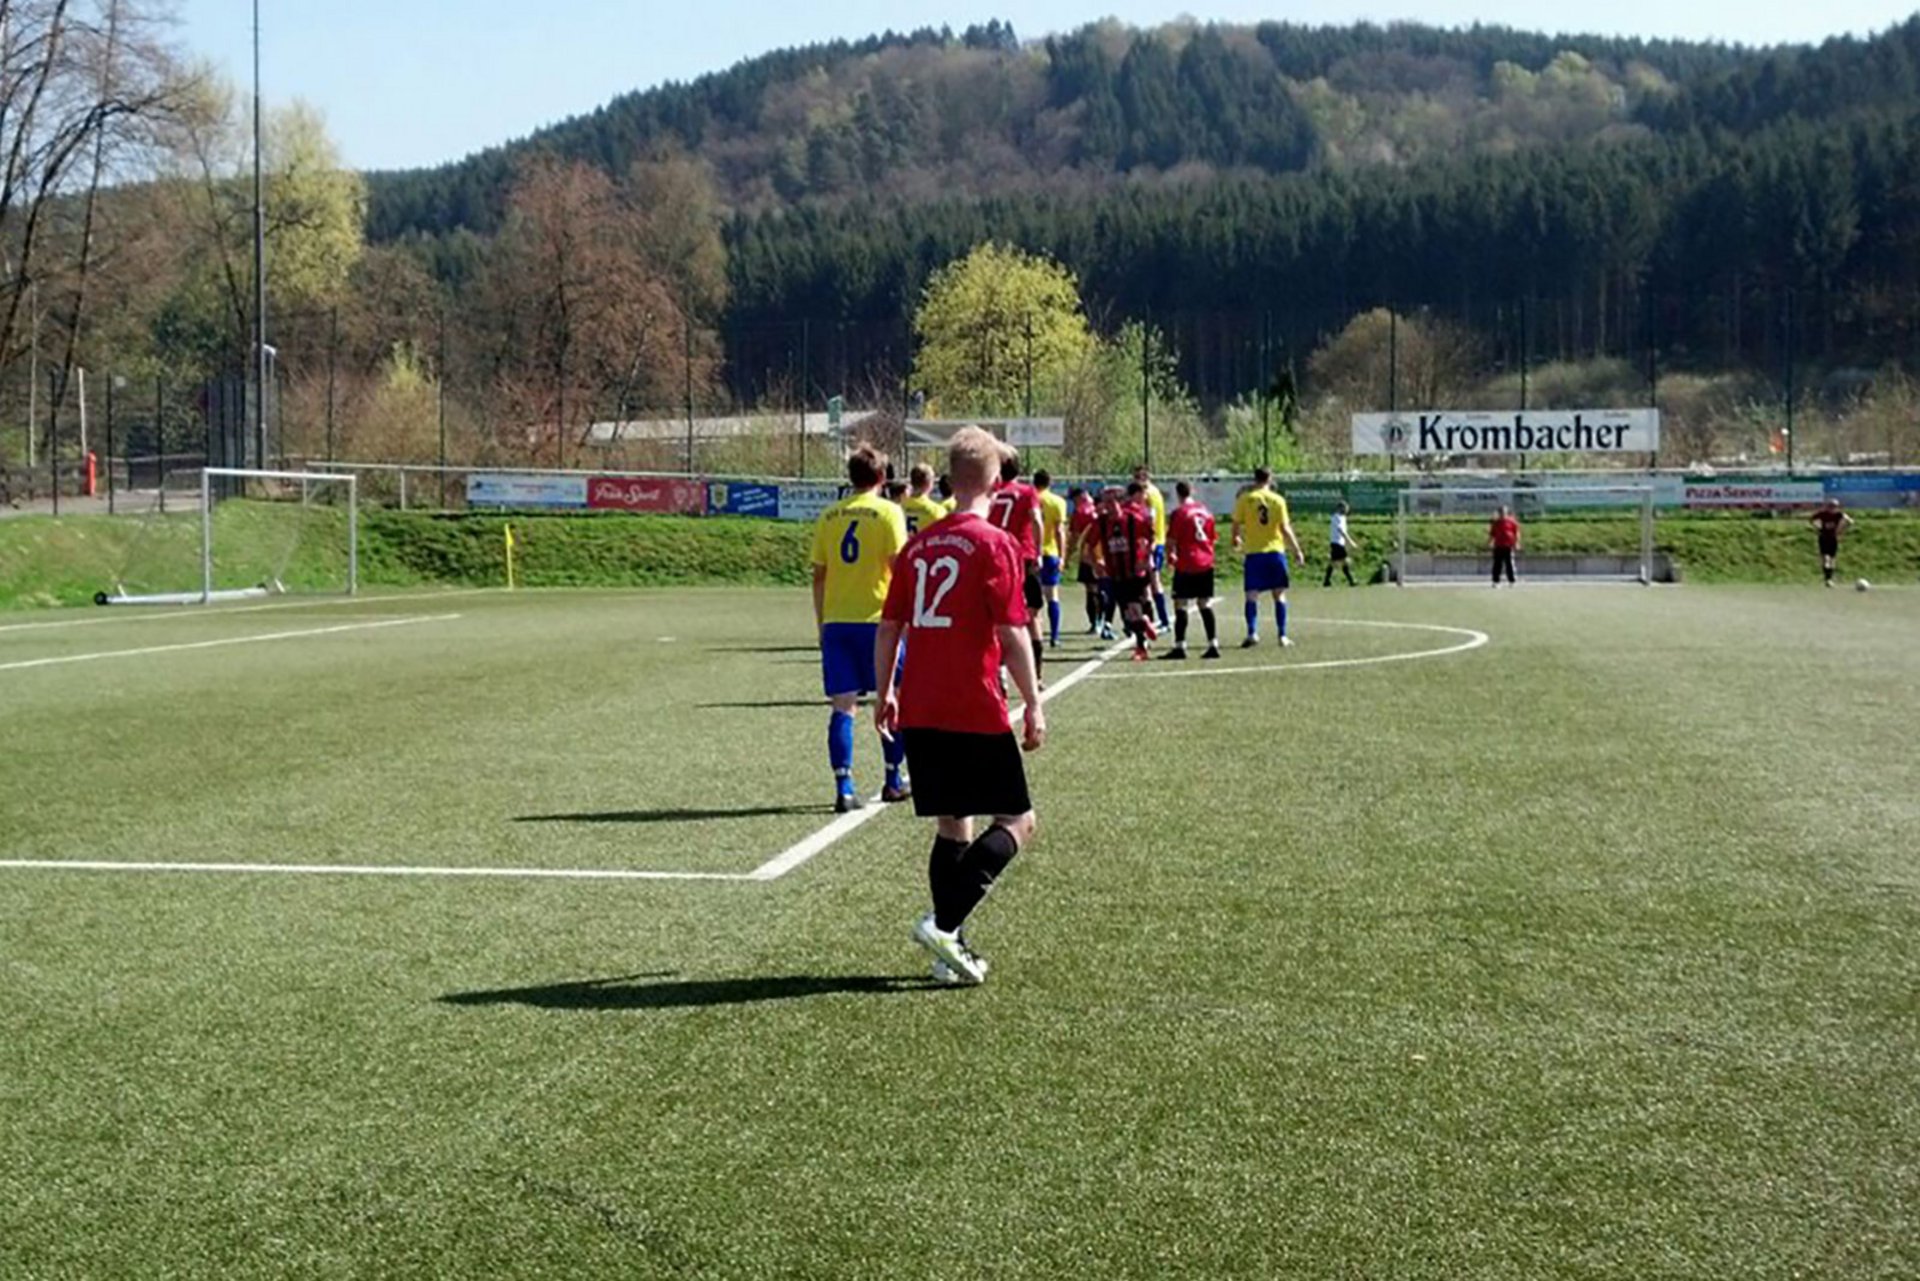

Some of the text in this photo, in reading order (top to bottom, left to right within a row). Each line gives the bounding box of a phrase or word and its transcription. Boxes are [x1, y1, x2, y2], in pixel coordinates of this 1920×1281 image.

[1419, 413, 1630, 450] Krombacher
[993, 498, 1013, 528] 7
[1257, 504, 1269, 526] 3
[840, 519, 860, 564] 6
[912, 555, 960, 628] 12
